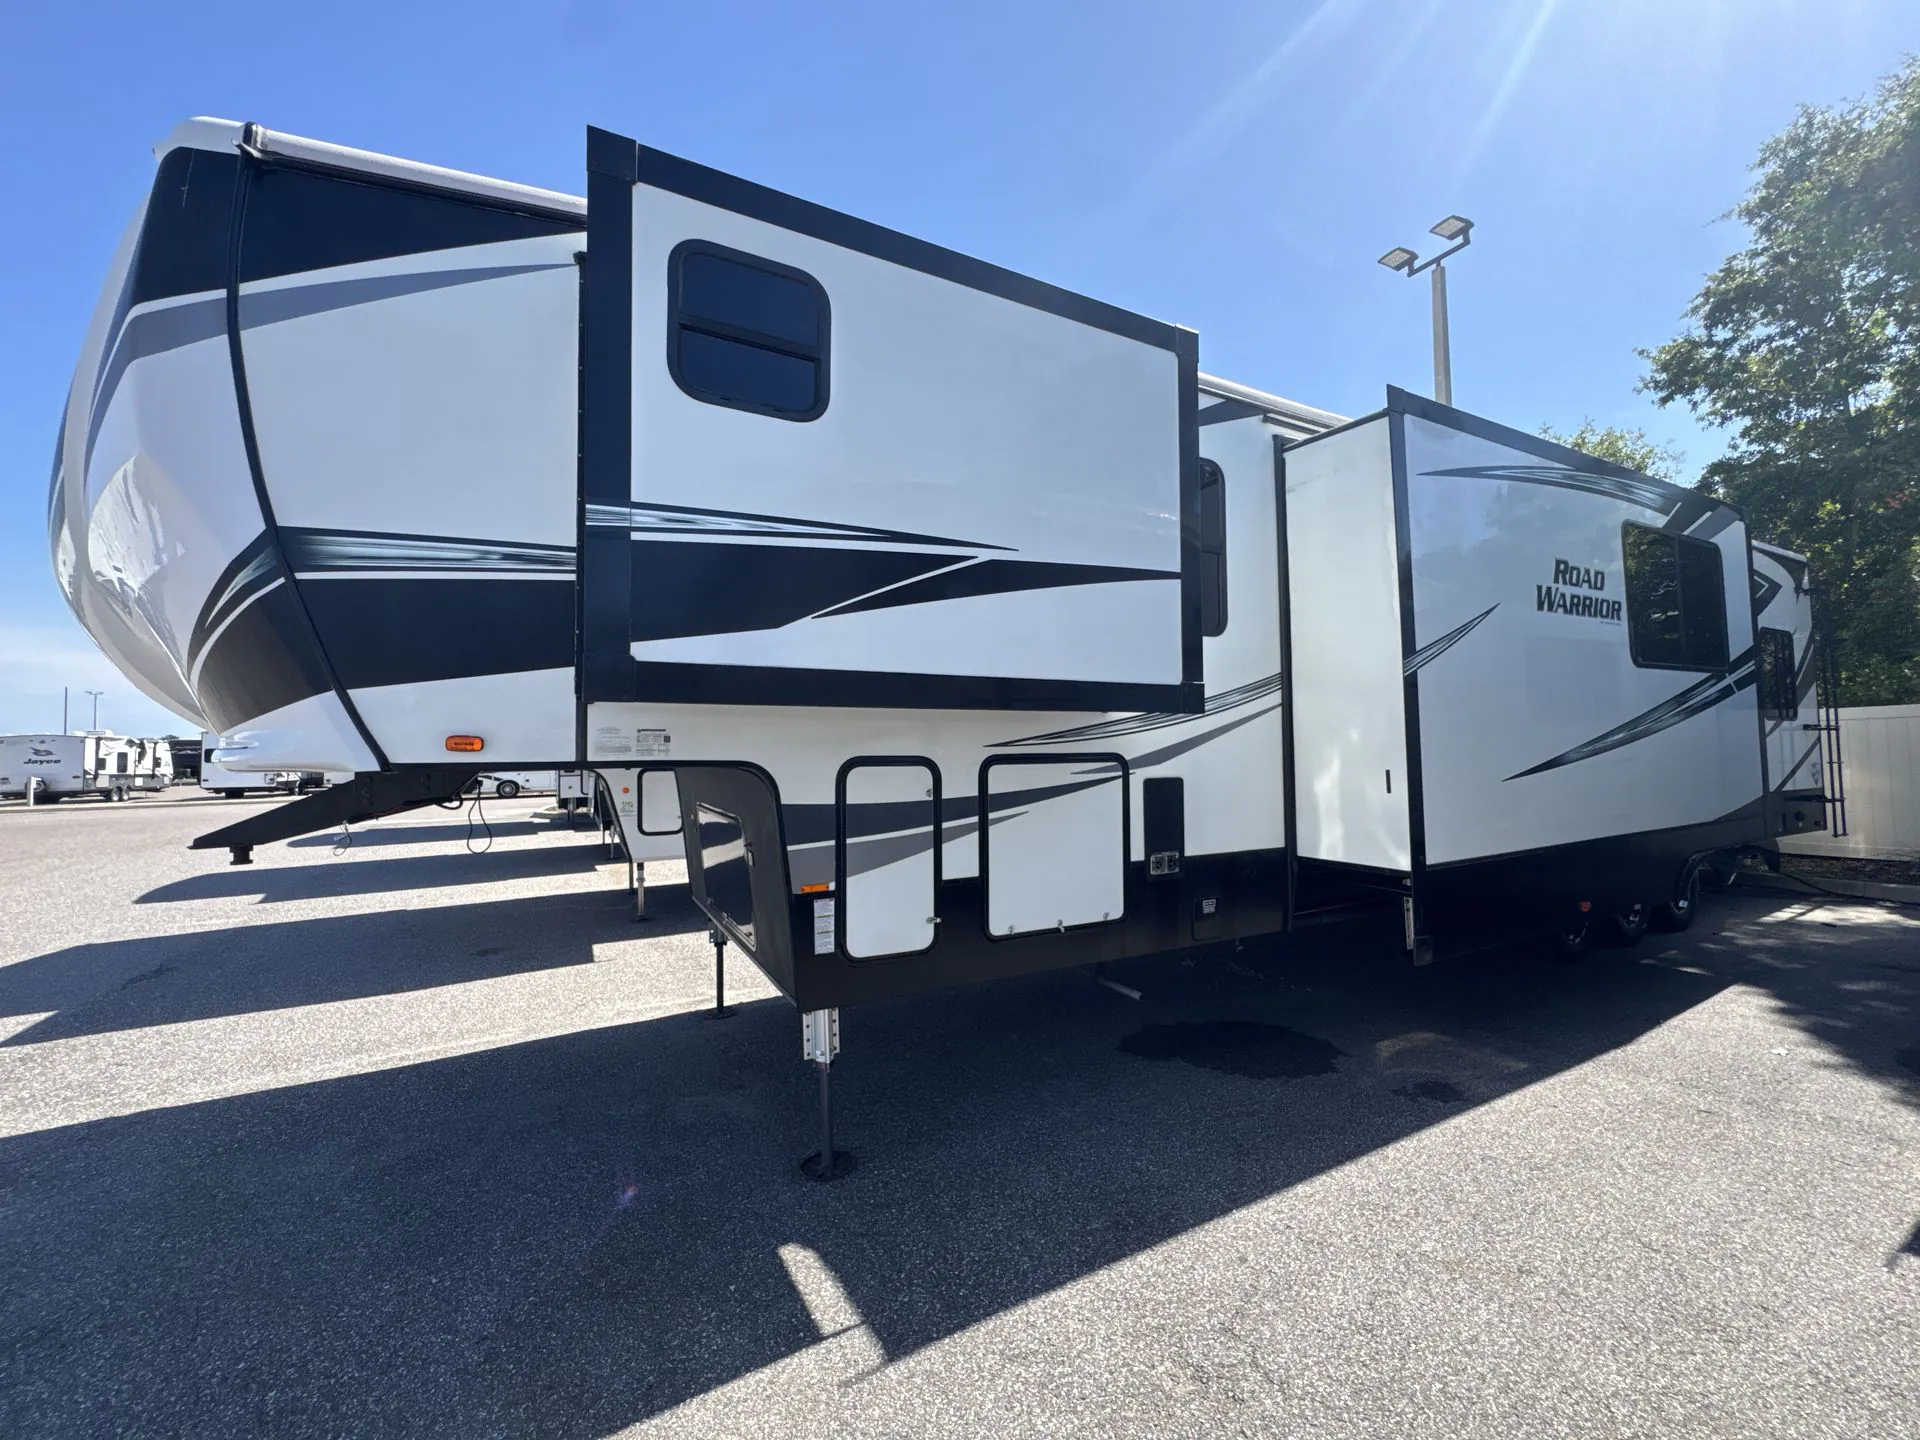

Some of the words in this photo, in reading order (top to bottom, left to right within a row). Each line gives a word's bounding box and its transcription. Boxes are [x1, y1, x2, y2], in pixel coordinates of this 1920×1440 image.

[1553, 558, 1605, 591] ROAD
[1536, 584, 1622, 621] WARRIOR
[23, 758, 61, 766] Jayco
